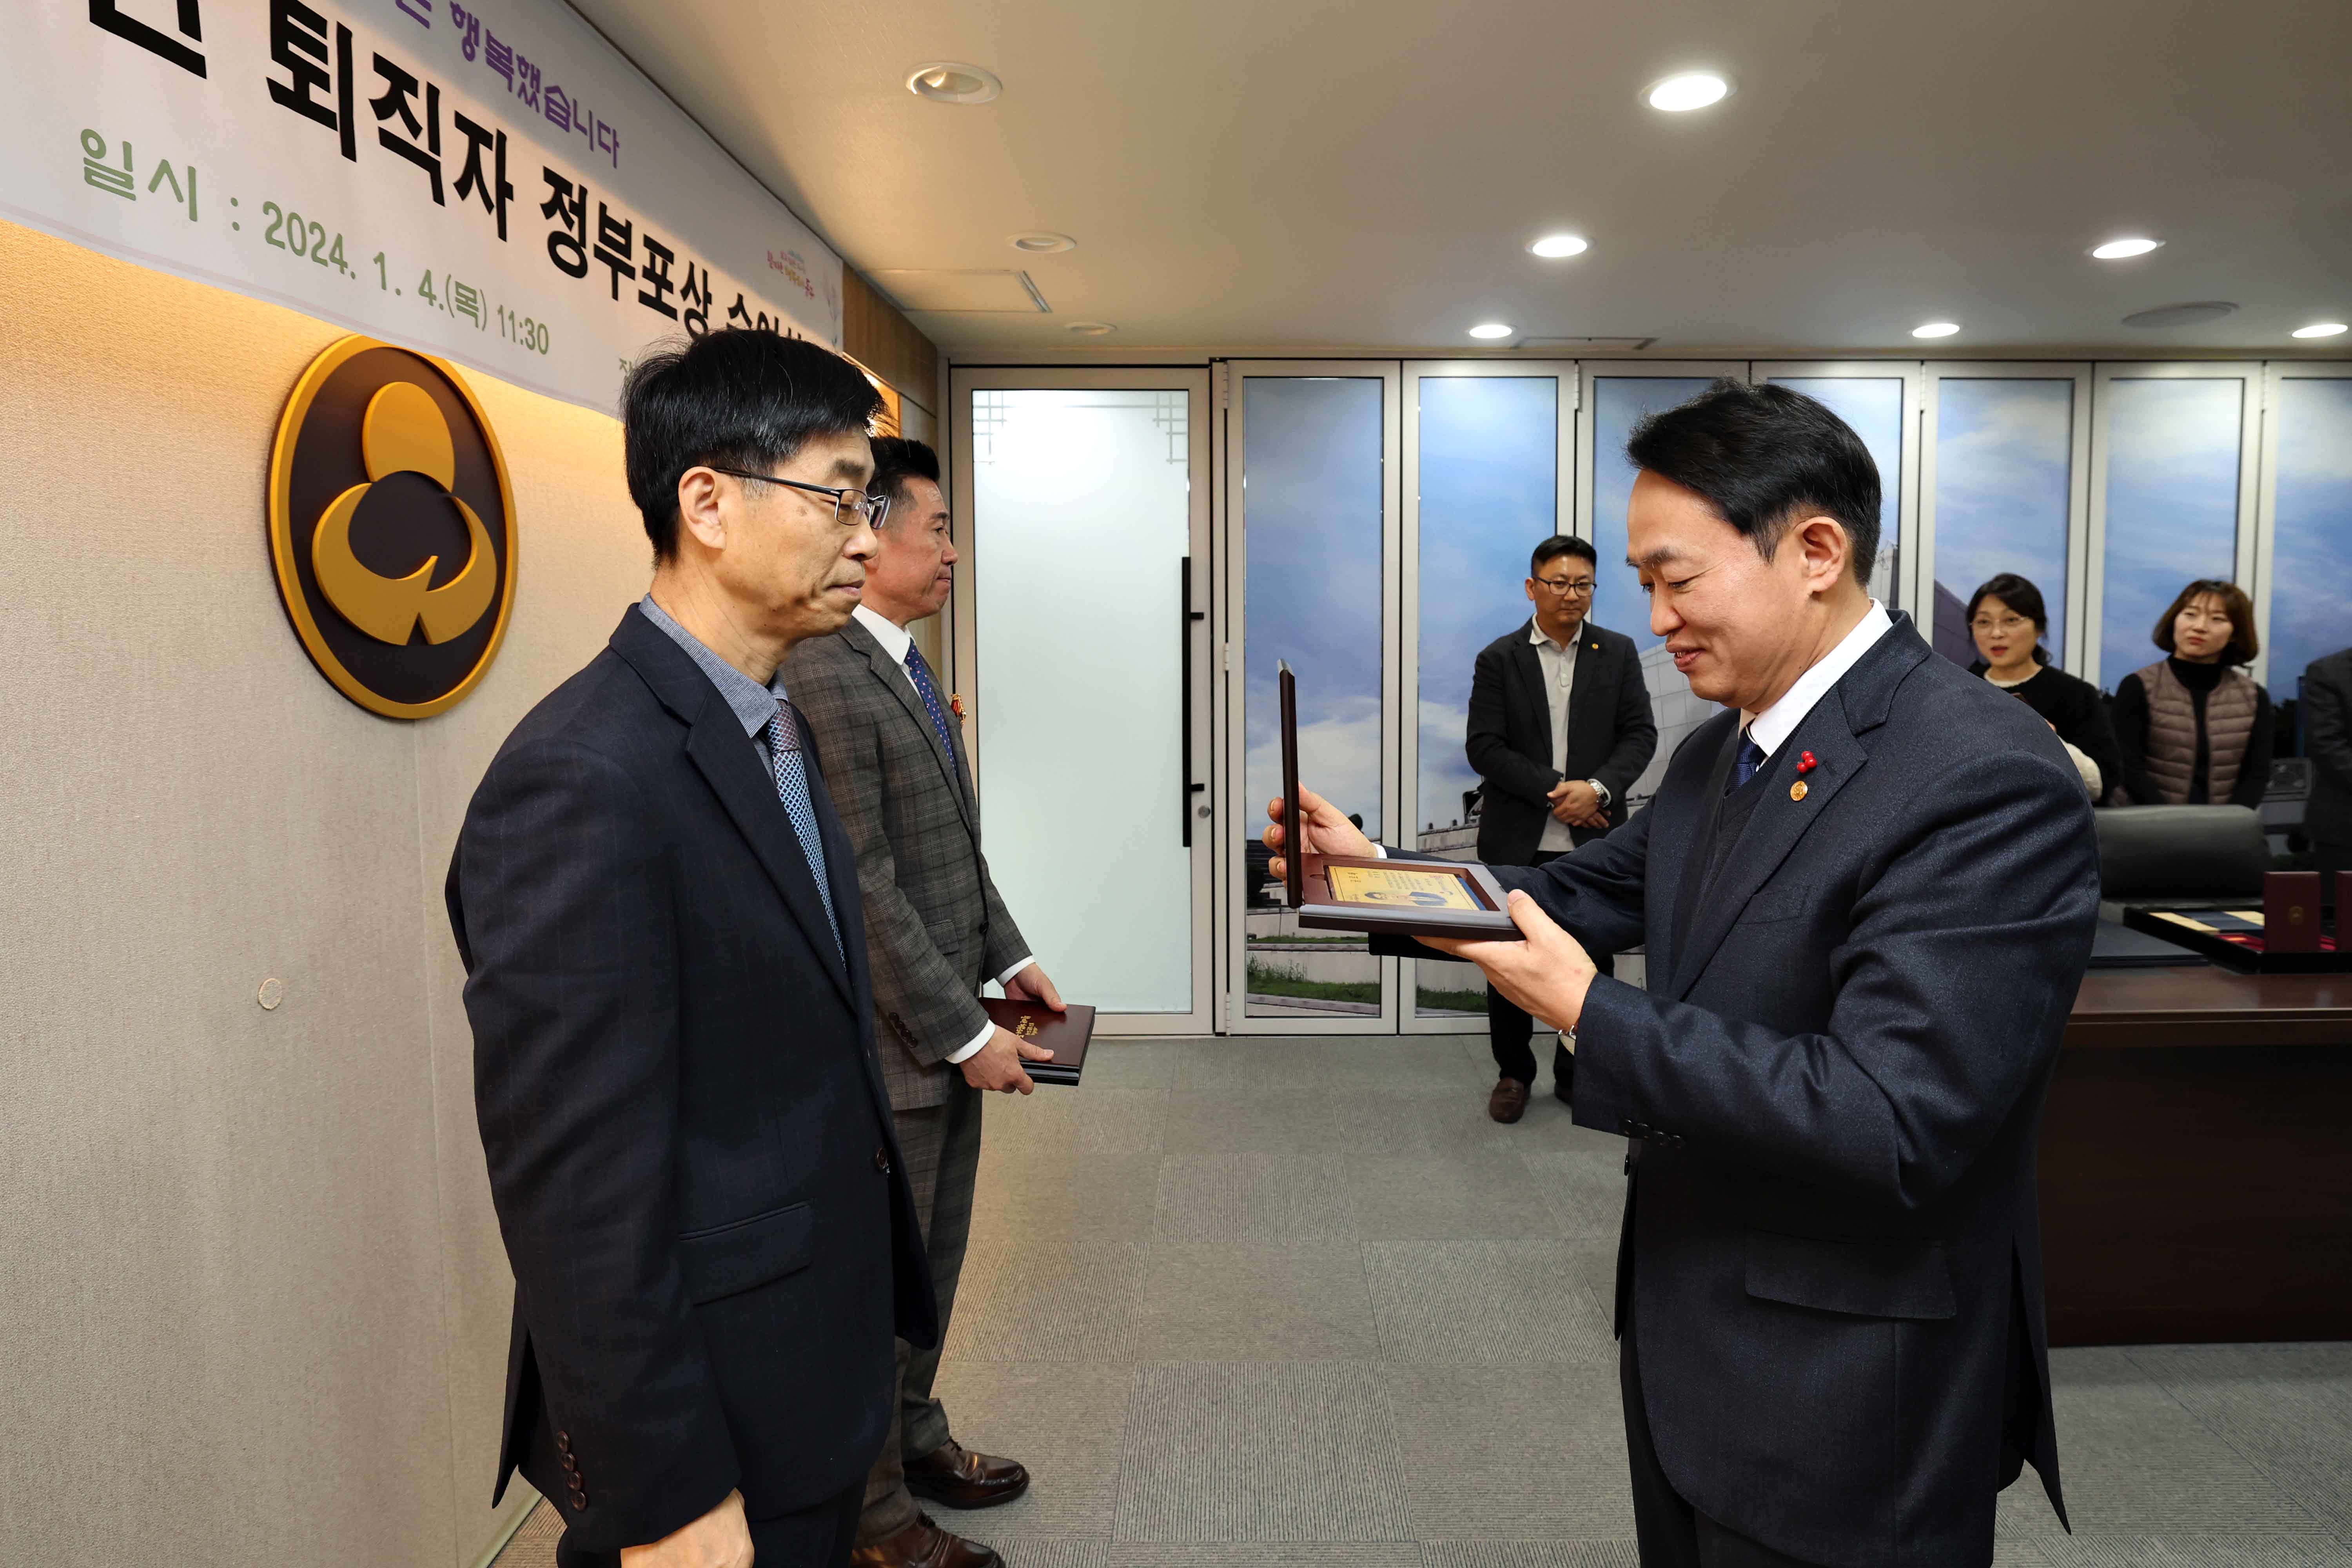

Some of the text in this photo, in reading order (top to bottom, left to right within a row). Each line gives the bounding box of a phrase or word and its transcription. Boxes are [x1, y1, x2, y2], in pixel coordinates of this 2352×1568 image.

[266, 0, 712, 340] 퇴직자 정부포상
[450, 0, 620, 169] 행복했습니다
[81, 129, 198, 221] 일시
[231, 198, 240, 231] :
[263, 201, 356, 279] 2024.
[374, 252, 401, 296] 1.
[498, 305, 549, 355] 11:30
